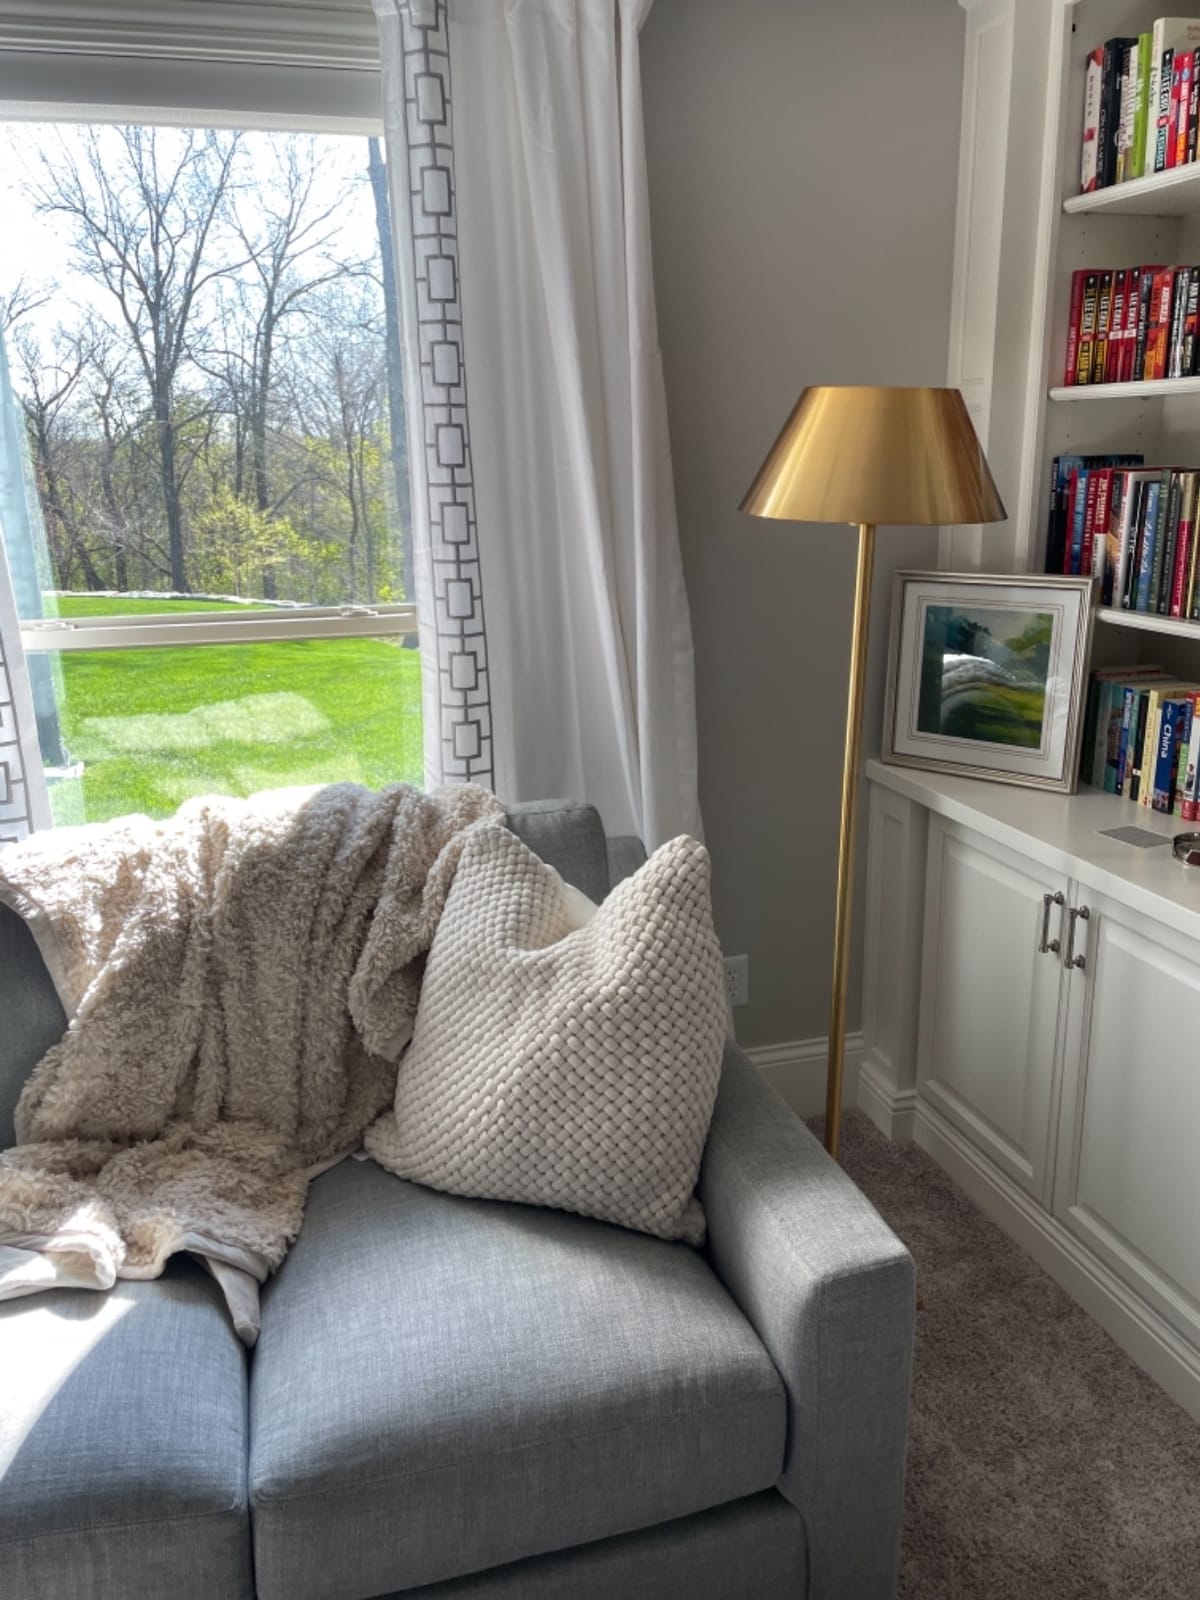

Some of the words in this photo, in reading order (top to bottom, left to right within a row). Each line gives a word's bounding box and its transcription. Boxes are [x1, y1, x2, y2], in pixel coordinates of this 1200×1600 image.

[1084, 298, 1094, 312] LEE
[1099, 296, 1108, 310] LEE
[1114, 294, 1123, 308] LEE
[1129, 291, 1137, 306] LEE
[1082, 312, 1093, 333] CHILD
[1098, 311, 1108, 332] CHILD
[1112, 309, 1122, 330] CHILD
[1127, 307, 1136, 329] CHILD
[1084, 507, 1093, 546] INNOCENCE
[1161, 724, 1171, 758] China
